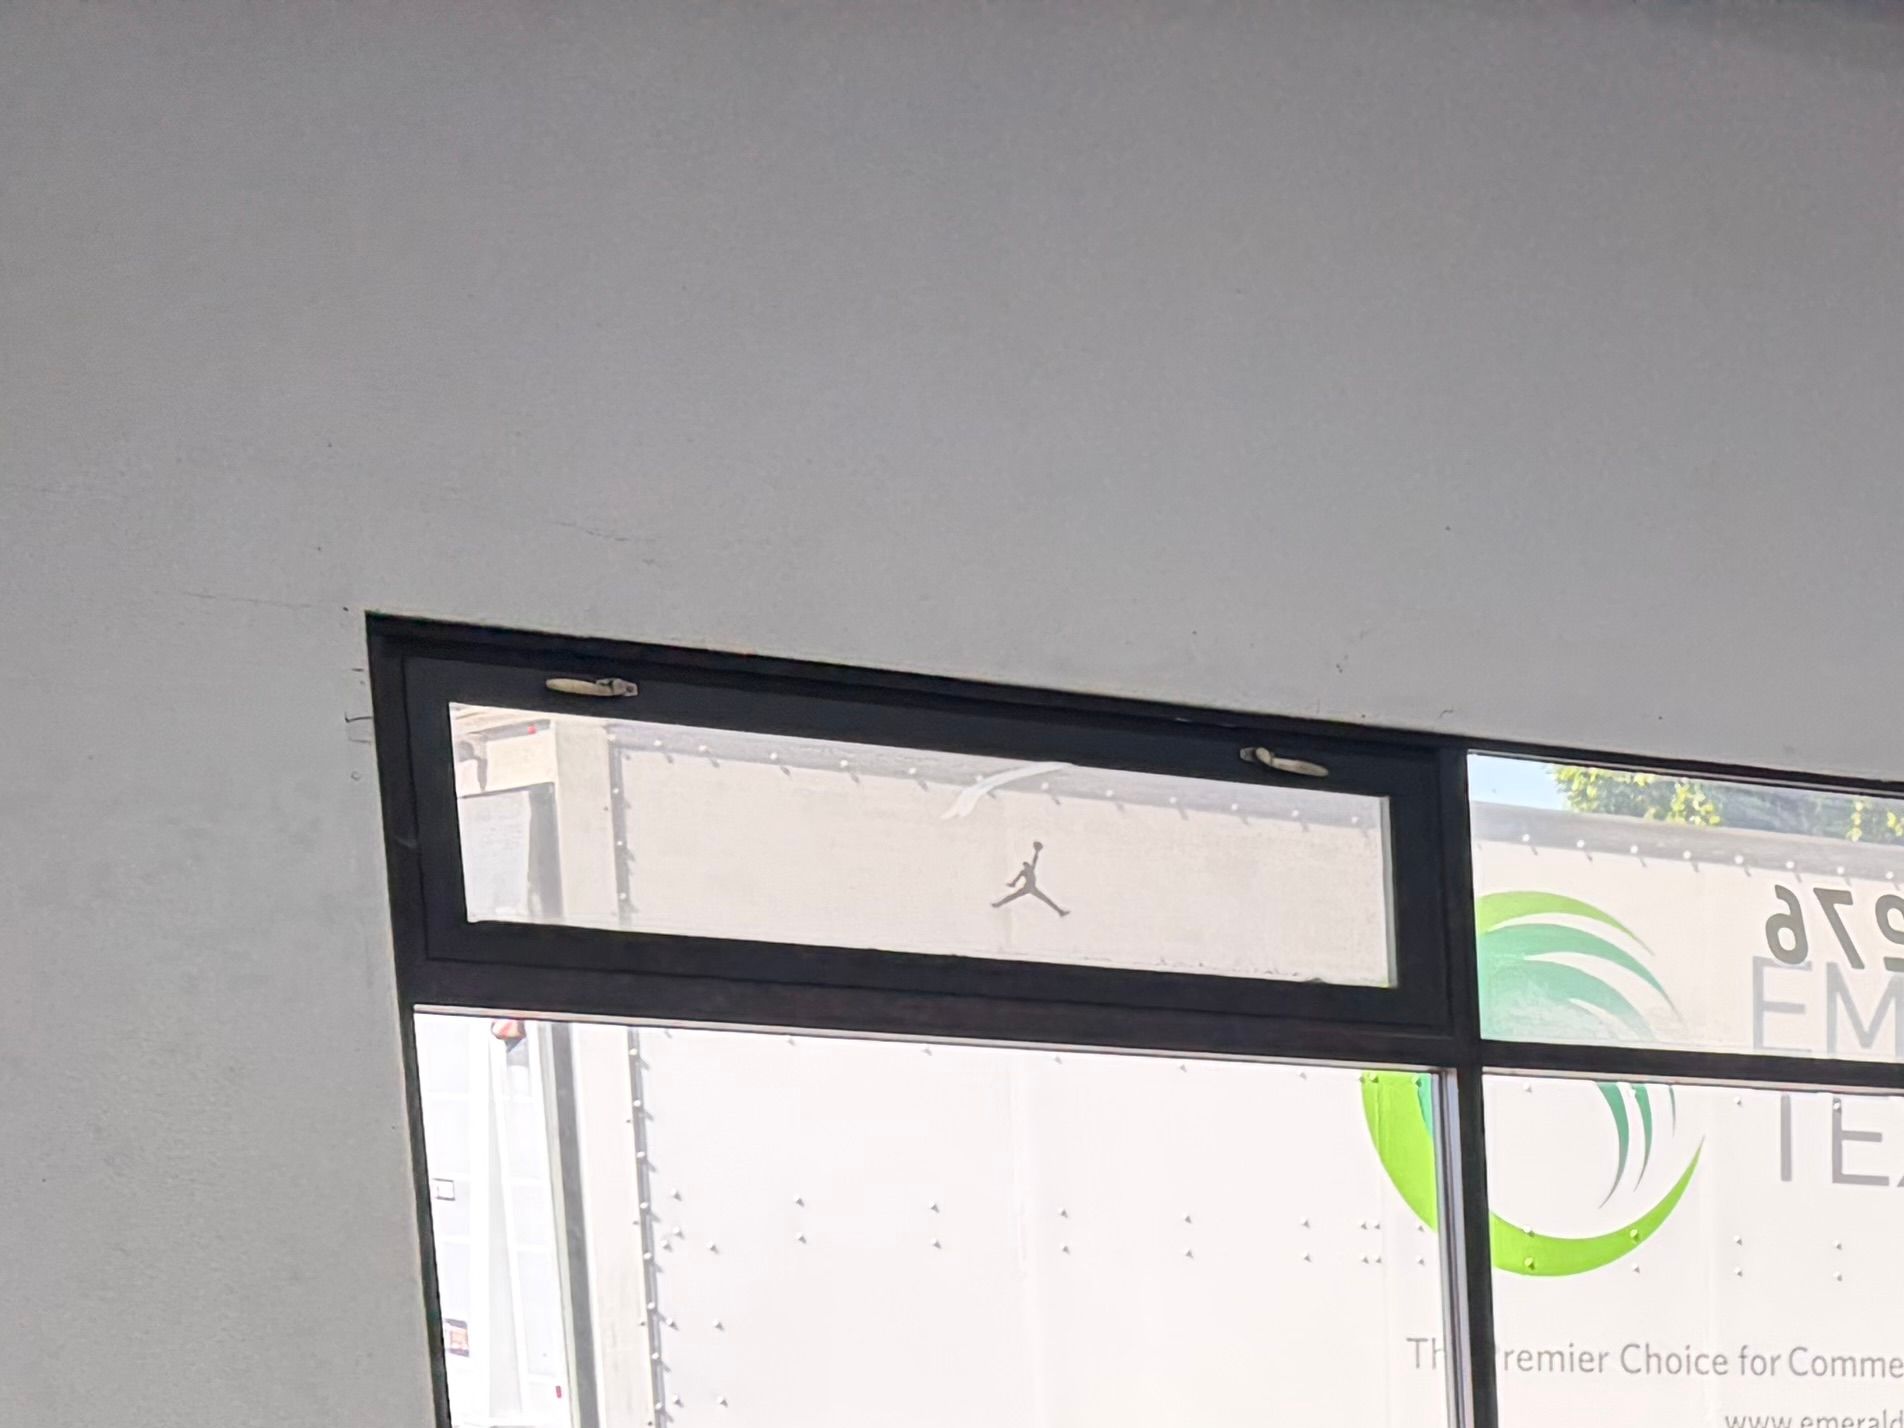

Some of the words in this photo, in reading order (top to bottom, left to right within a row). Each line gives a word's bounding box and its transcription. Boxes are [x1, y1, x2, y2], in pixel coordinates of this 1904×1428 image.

[1406, 1337, 1446, 1370] Th
[1503, 1342, 1610, 1374] remier
[1620, 1343, 1729, 1376] Choice
[1738, 1345, 1781, 1377] for
